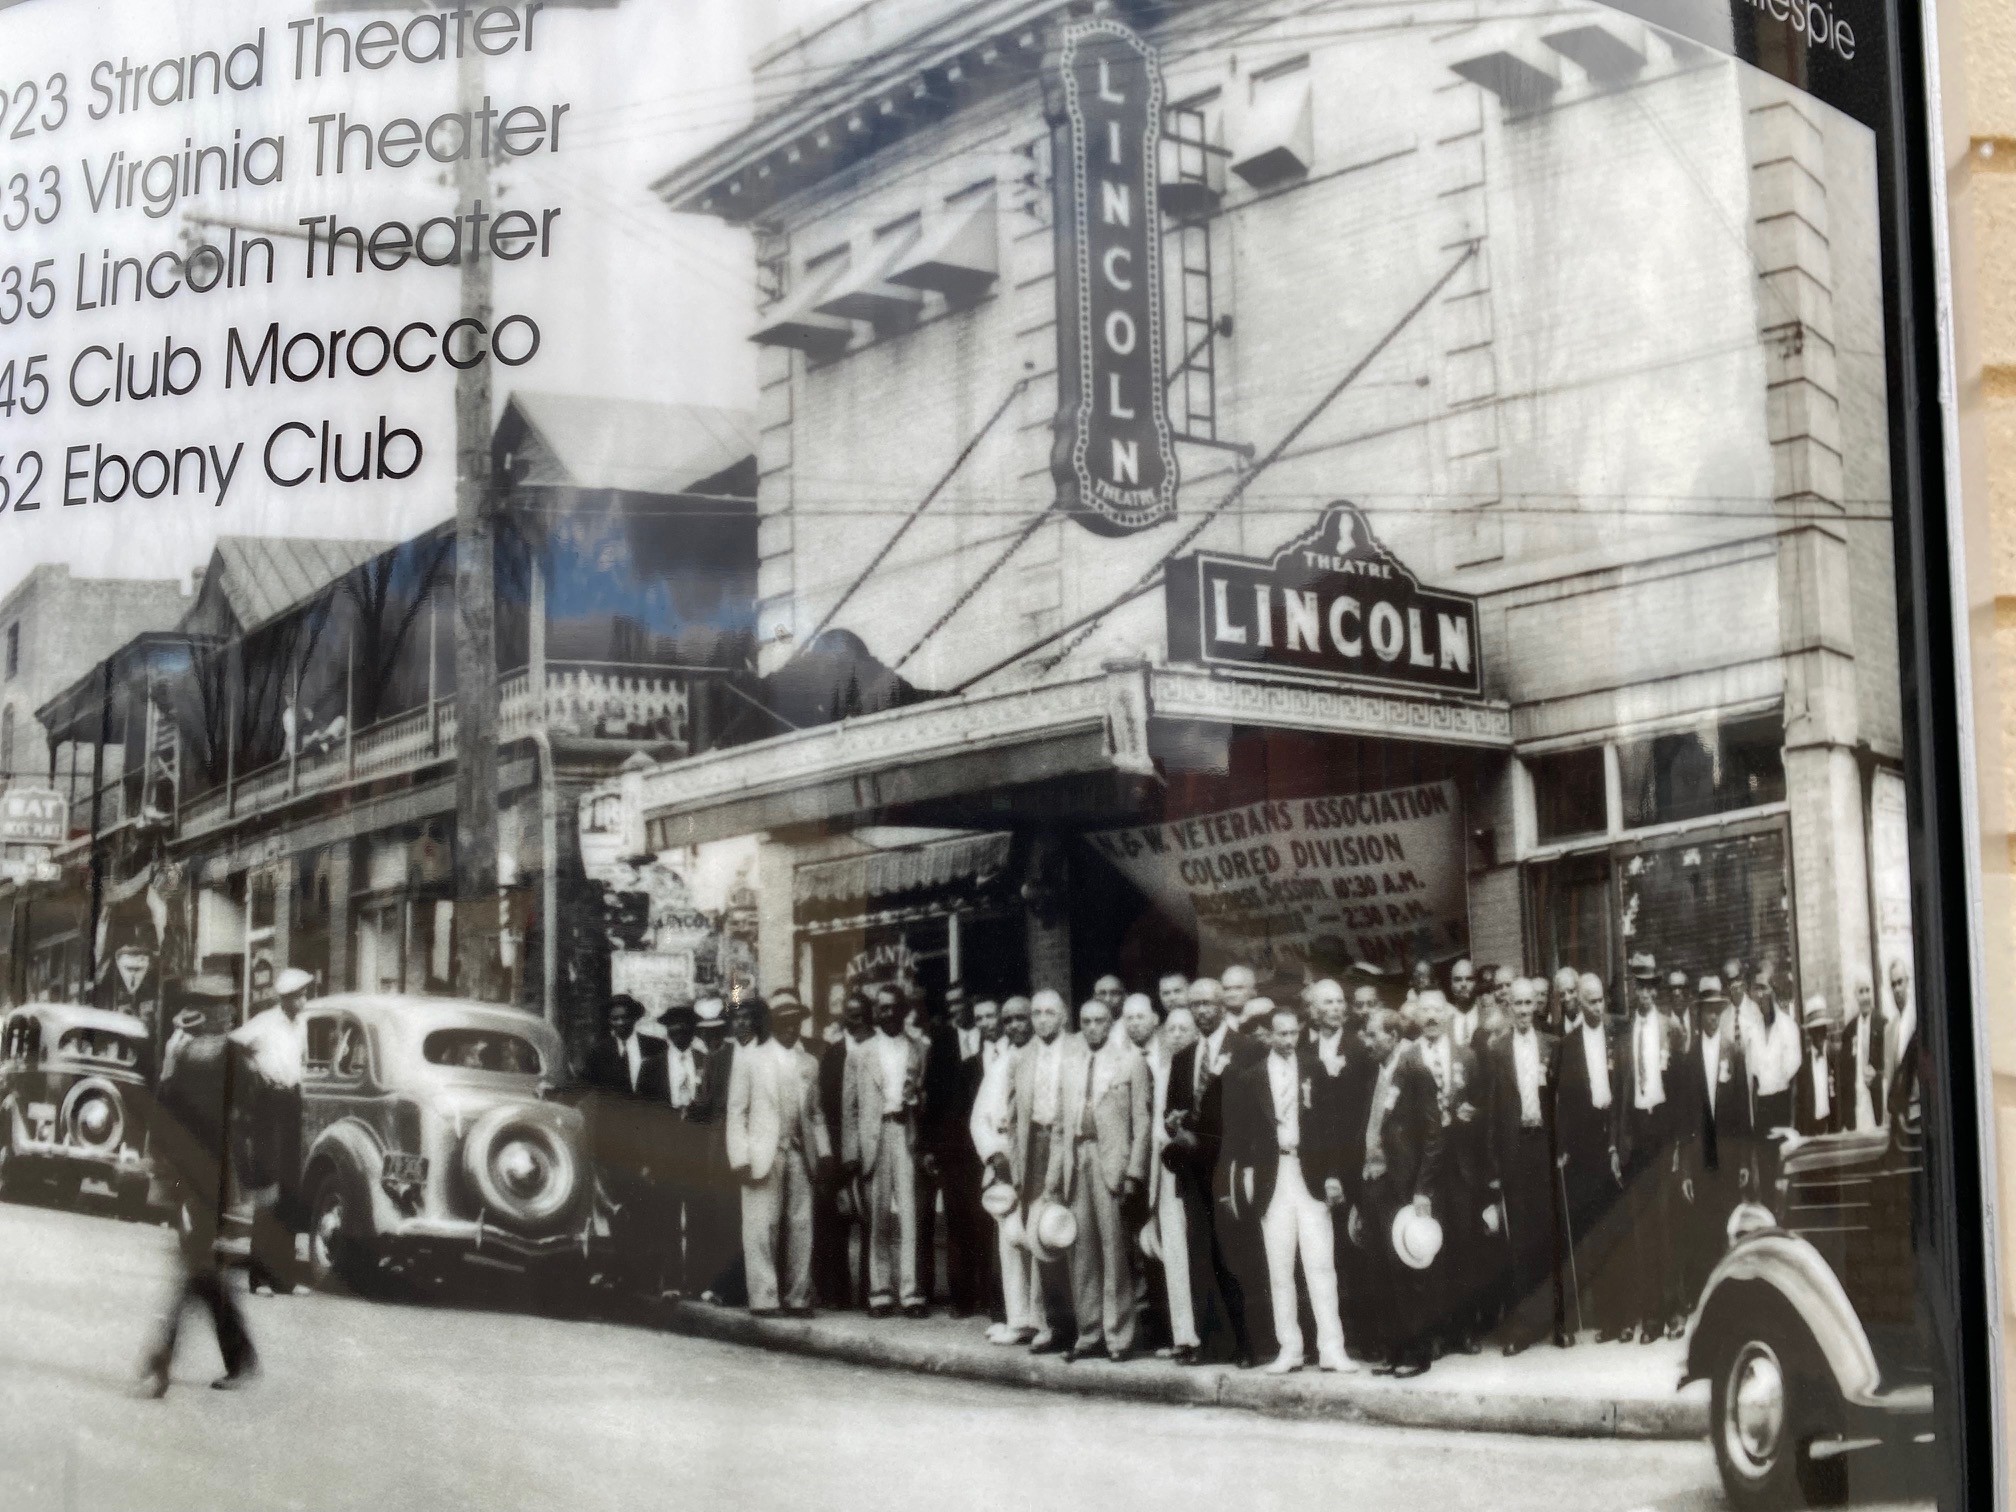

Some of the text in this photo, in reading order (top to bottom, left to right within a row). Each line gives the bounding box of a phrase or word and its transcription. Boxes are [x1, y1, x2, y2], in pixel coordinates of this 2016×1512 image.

[88, 27, 265, 121] Strand
[288, 2, 543, 80] Theater
[1744, 0, 1856, 60] espie
[82, 129, 284, 219] Virginia
[309, 96, 570, 177] Theater
[0, 199, 561, 325] 35 Lincoln Theater
[1099, 57, 1139, 485] LINCOLN
[0, 314, 541, 419] 45 Club Morocco
[62, 441, 244, 507] Ebony
[264, 416, 423, 487] Club
[1303, 551, 1393, 580] THEATRE
[1212, 578, 1471, 674] LINCOLN
[1170, 801, 1294, 851] VETERANS
[1303, 784, 1450, 831] ASSOCIATION
[1179, 833, 1405, 888] COLORED DIVISION
